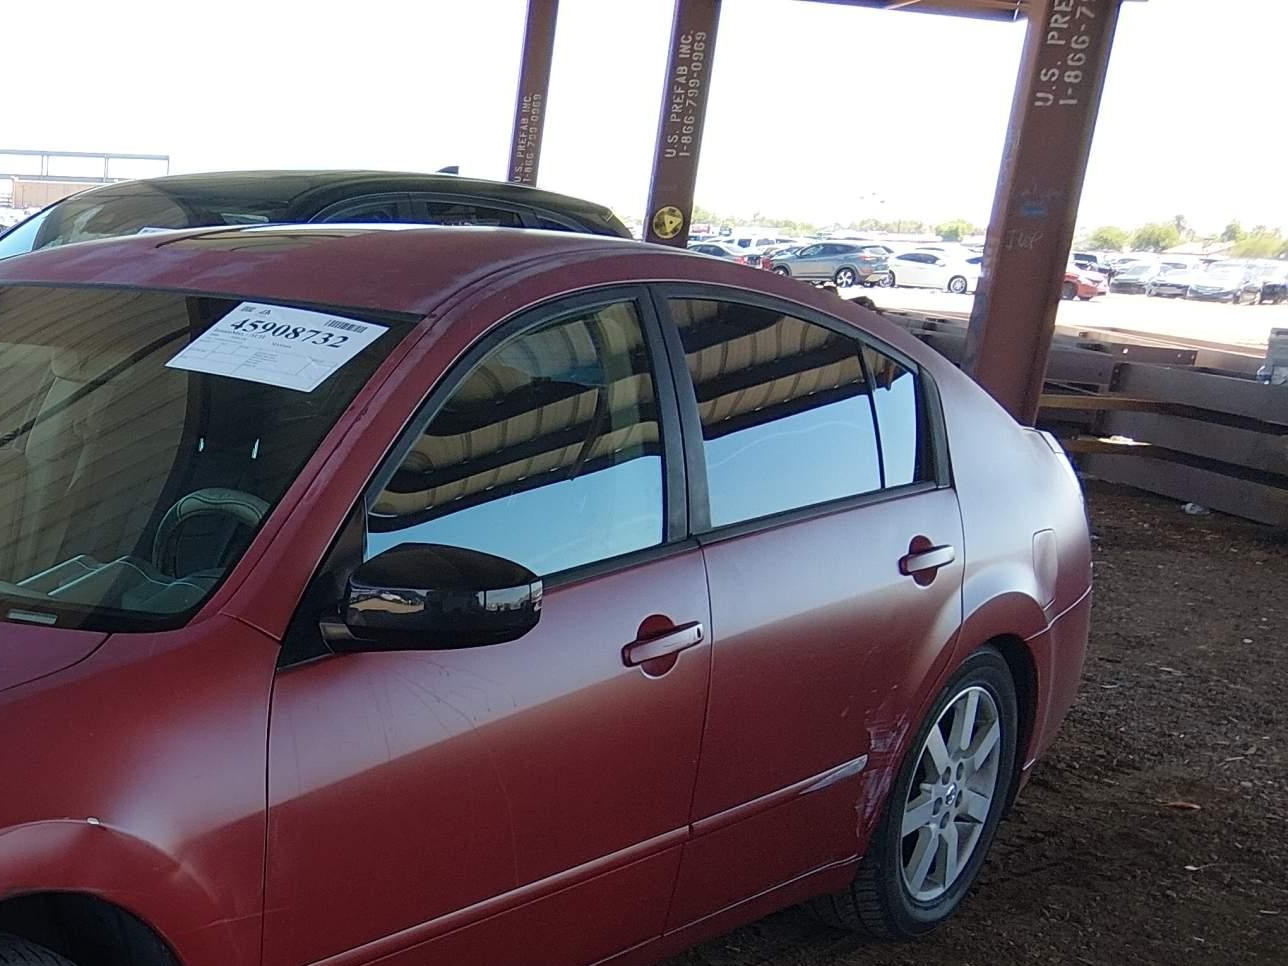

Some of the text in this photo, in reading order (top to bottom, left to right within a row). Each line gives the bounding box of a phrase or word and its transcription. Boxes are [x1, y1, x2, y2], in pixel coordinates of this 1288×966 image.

[1034, 61, 1062, 106] U.S.
[1059, 0, 1095, 105] 1-866-7
[664, 30, 694, 158] U.S. PREFAB INC.
[678, 31, 707, 157] 1-866-799-0969
[516, 118, 529, 158] PREFAB
[230, 318, 350, 349] 45908732
